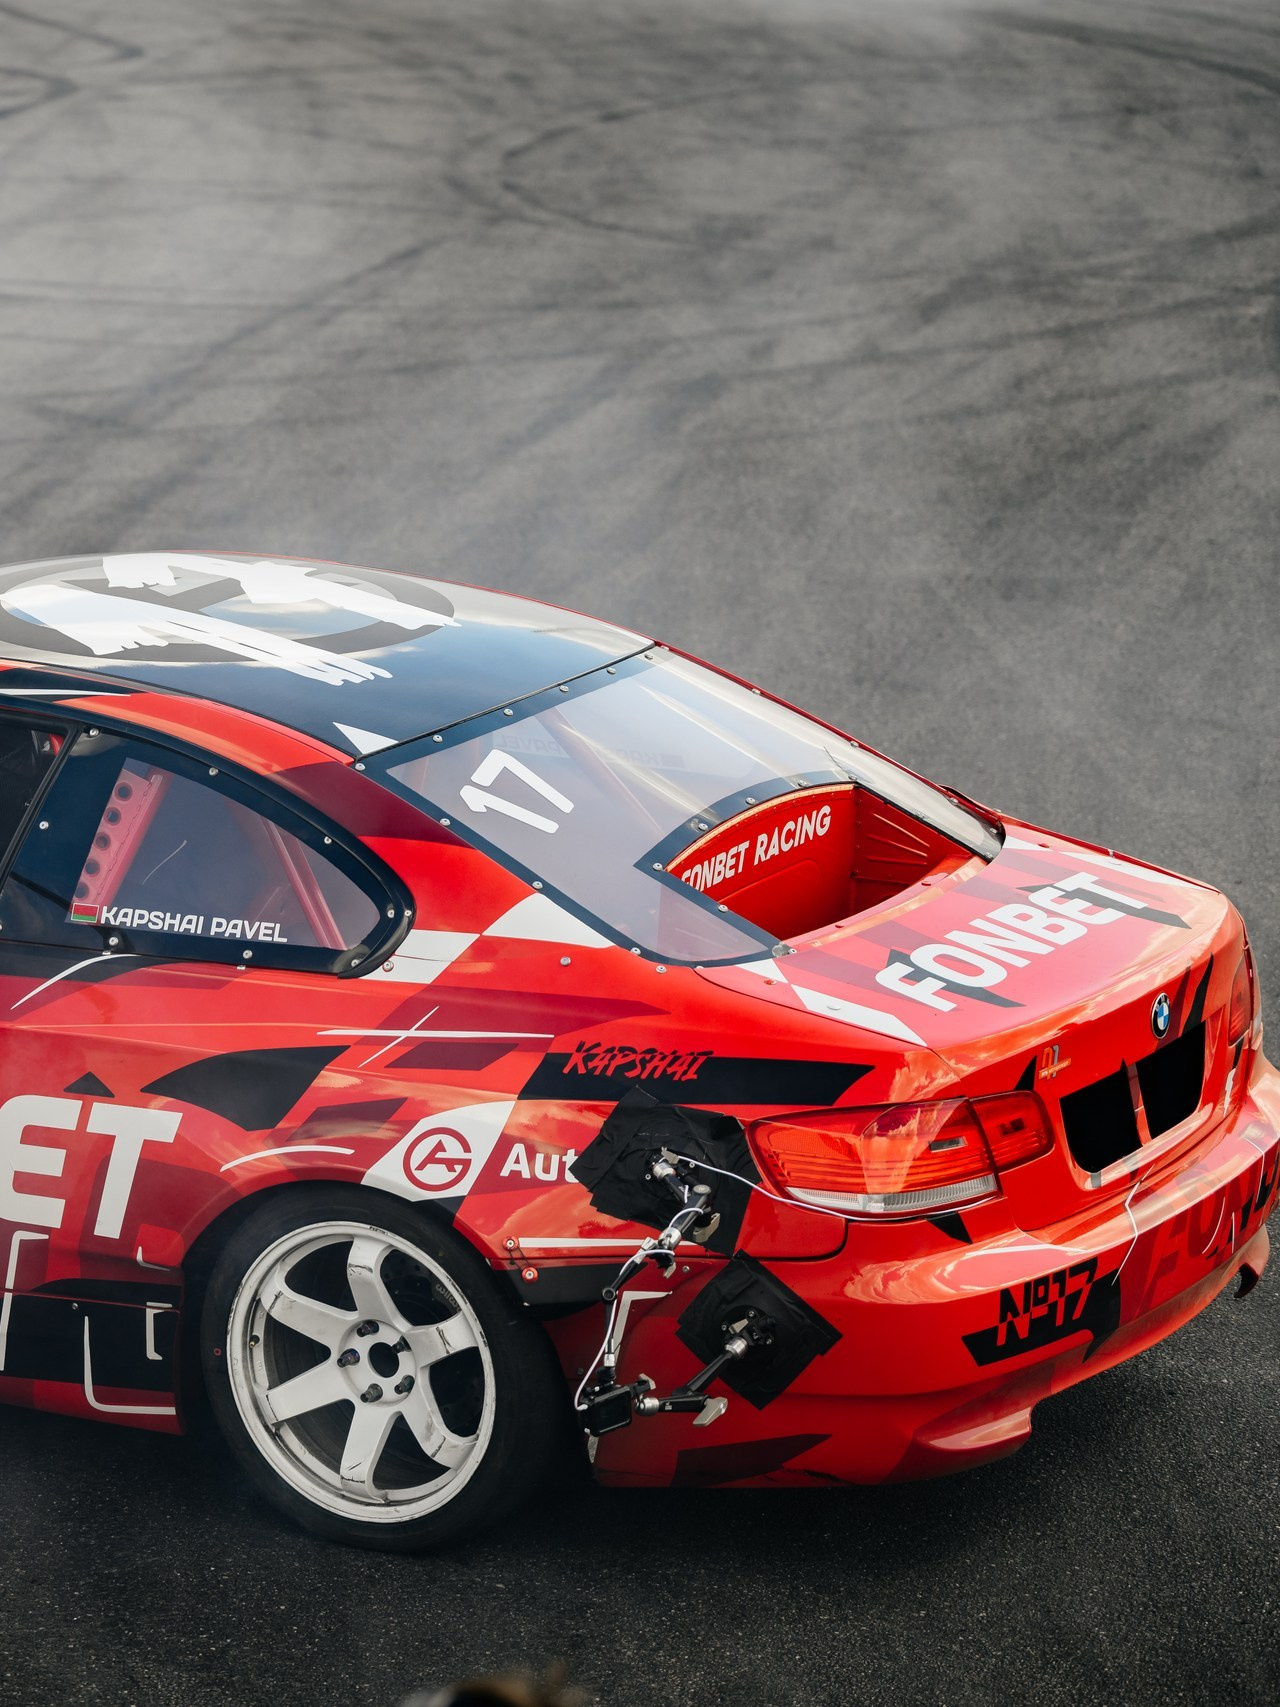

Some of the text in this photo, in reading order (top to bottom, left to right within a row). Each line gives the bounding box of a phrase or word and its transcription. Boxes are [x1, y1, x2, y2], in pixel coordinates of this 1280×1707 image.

[459, 749, 575, 834] 17
[754, 805, 832, 866] RACING
[100, 905, 288, 943] KAPSHAI PAVEL
[875, 871, 1150, 1012] FONBET
[562, 1040, 715, 1082] KAPSHAI
